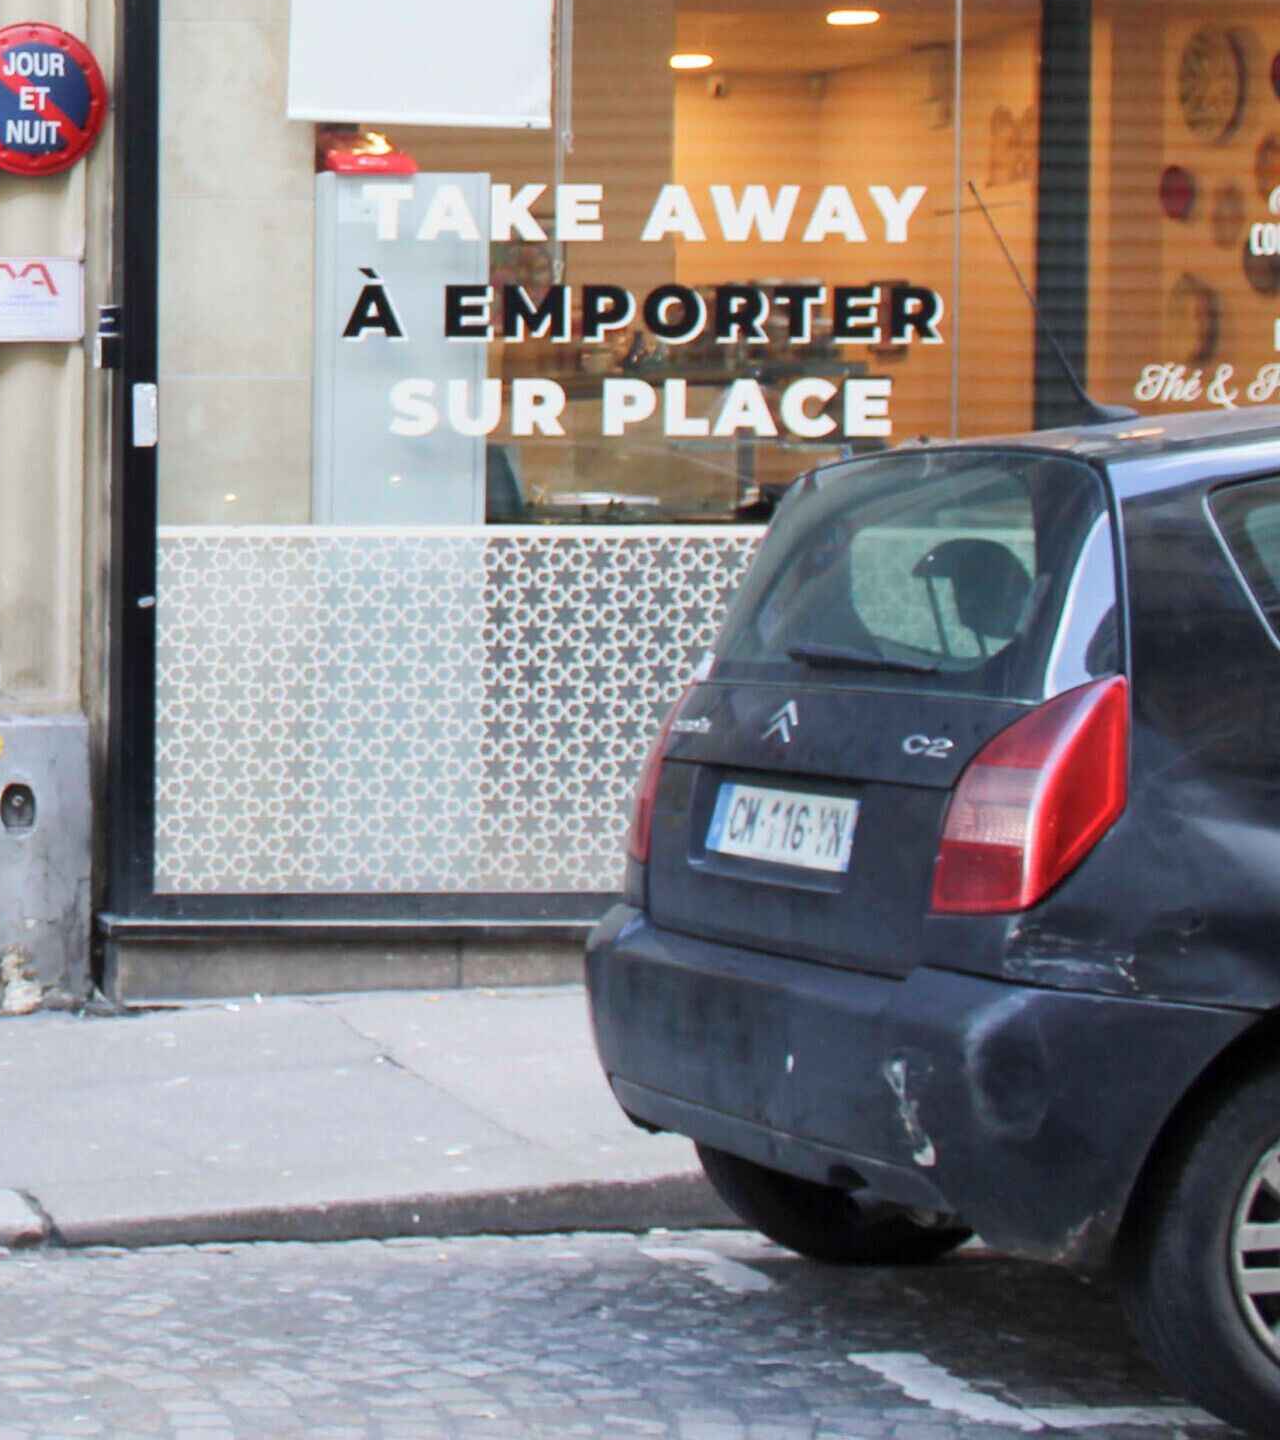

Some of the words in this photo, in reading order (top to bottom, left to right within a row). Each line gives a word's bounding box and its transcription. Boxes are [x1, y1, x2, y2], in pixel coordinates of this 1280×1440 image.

[3, 51, 66, 77] JOUR
[18, 86, 51, 112] ET
[4, 119, 62, 145] NUIT
[361, 184, 605, 242] TAKE
[641, 184, 928, 243] AWAY
[342, 267, 409, 343] À
[443, 283, 944, 345] EMPORTER
[1134, 362, 1202, 402] Thé
[1206, 364, 1238, 408] &
[388, 377, 566, 438] SUR
[602, 377, 893, 439] PLACE
[901, 733, 955, 759] C2
